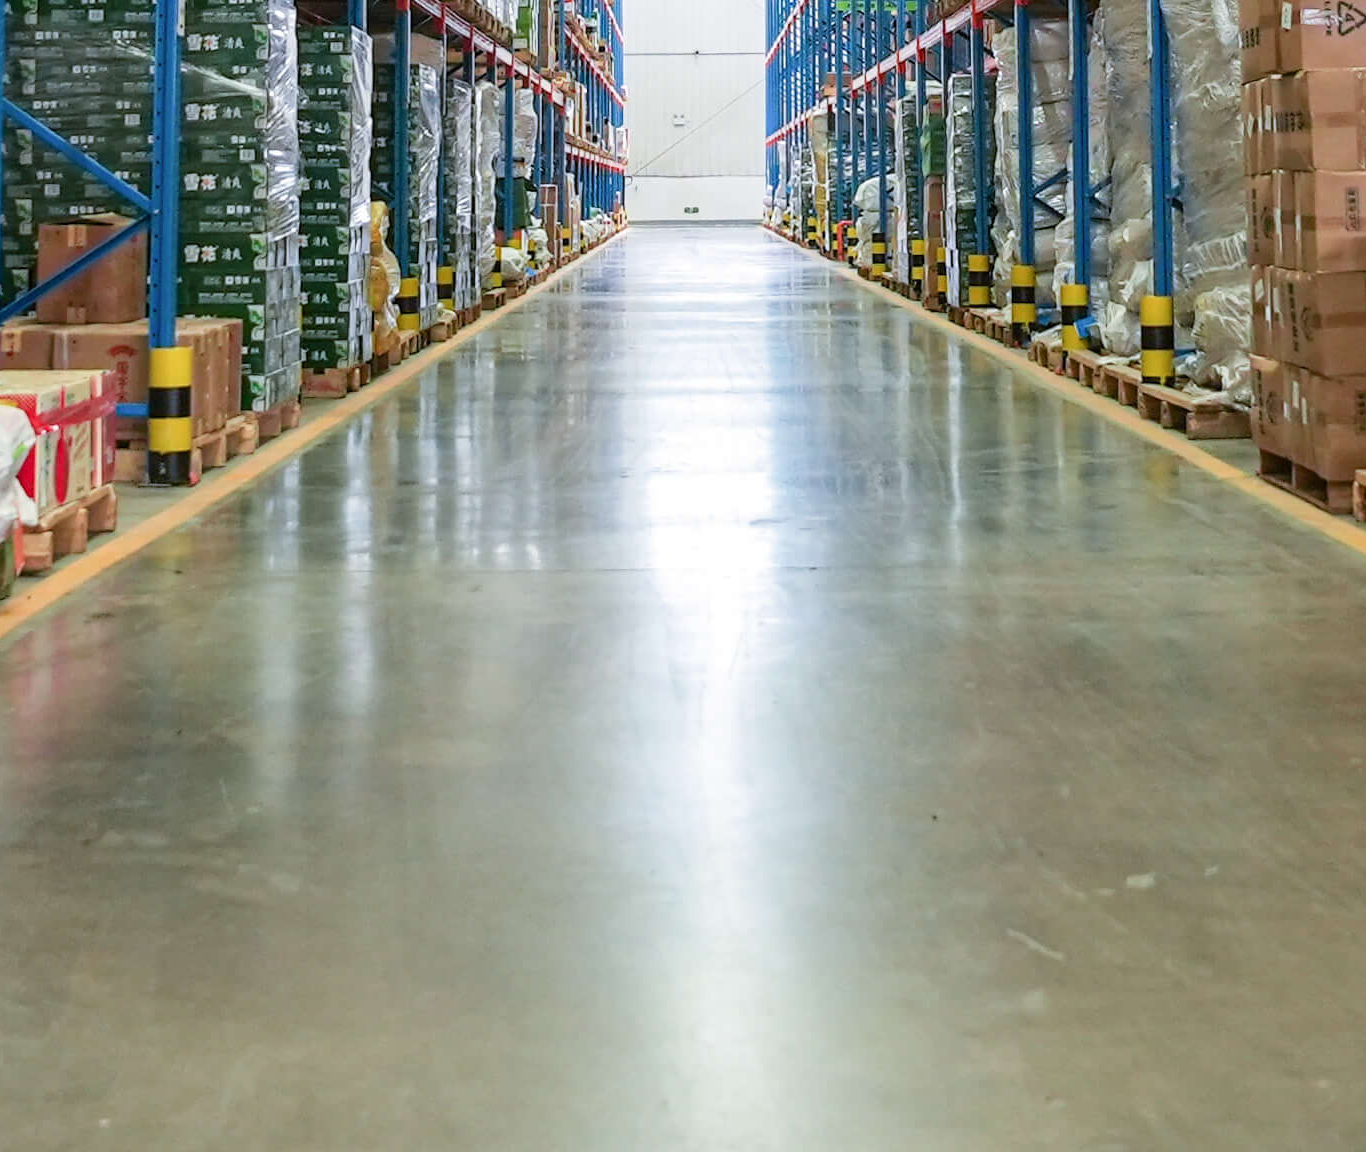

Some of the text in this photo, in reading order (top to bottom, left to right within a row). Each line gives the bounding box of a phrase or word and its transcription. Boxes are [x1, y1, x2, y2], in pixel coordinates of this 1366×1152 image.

[186, 33, 221, 52] 雪花
[185, 103, 221, 121] 雪花
[184, 172, 219, 191] 雪花
[184, 244, 219, 264] 雪花
